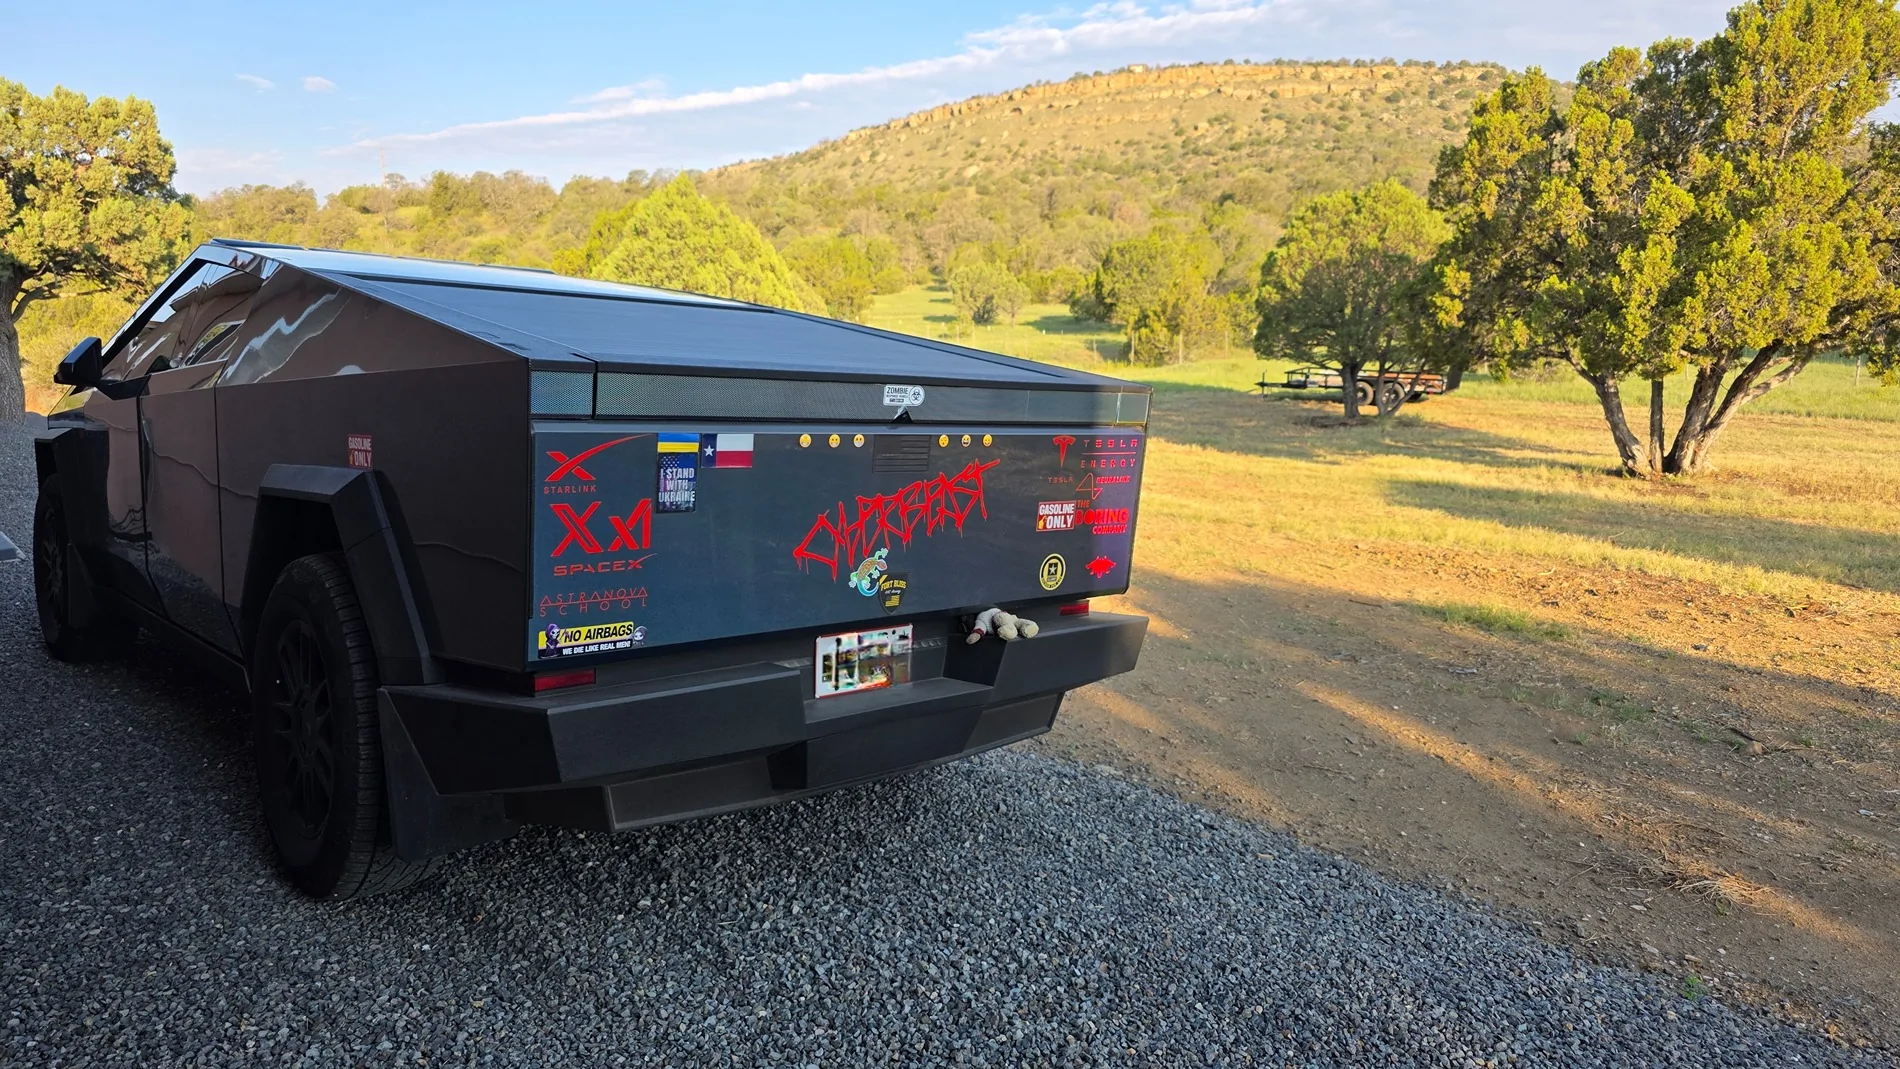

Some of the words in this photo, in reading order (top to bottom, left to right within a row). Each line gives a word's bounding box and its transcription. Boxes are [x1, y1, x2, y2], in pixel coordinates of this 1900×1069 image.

[886, 386, 909, 395] ZOMBIE
[348, 436, 372, 451] GASOLINE
[1083, 438, 1138, 448] TESLA
[354, 450, 372, 468] ONLY
[1080, 458, 1136, 469] ENERGY
[660, 468, 664, 479] I
[666, 467, 695, 479] STAND
[666, 479, 689, 491] WITH
[1047, 476, 1074, 484] TESLA
[543, 485, 597, 495] STARLINK
[658, 490, 696, 503] UKRAINE
[1039, 503, 1075, 516] GASOLINE
[1077, 499, 1091, 508] THE
[1046, 514, 1074, 529] ONLY
[1075, 507, 1130, 526] BORING
[1092, 524, 1128, 535] COMPANY
[553, 552, 659, 577] SPACEX
[880, 580, 893, 591] FORT
[893, 579, 907, 589] BLISS
[540, 586, 649, 607] ASTRANOVA
[540, 597, 647, 618] SCHOOL
[563, 630, 582, 643] NO
[584, 623, 634, 642] AIRBAGS
[562, 647, 573, 656] WE
[573, 646, 585, 655] DIE
[585, 644, 600, 653] LIKE
[600, 642, 616, 651] REAL
[616, 640, 631, 649] MEN!
